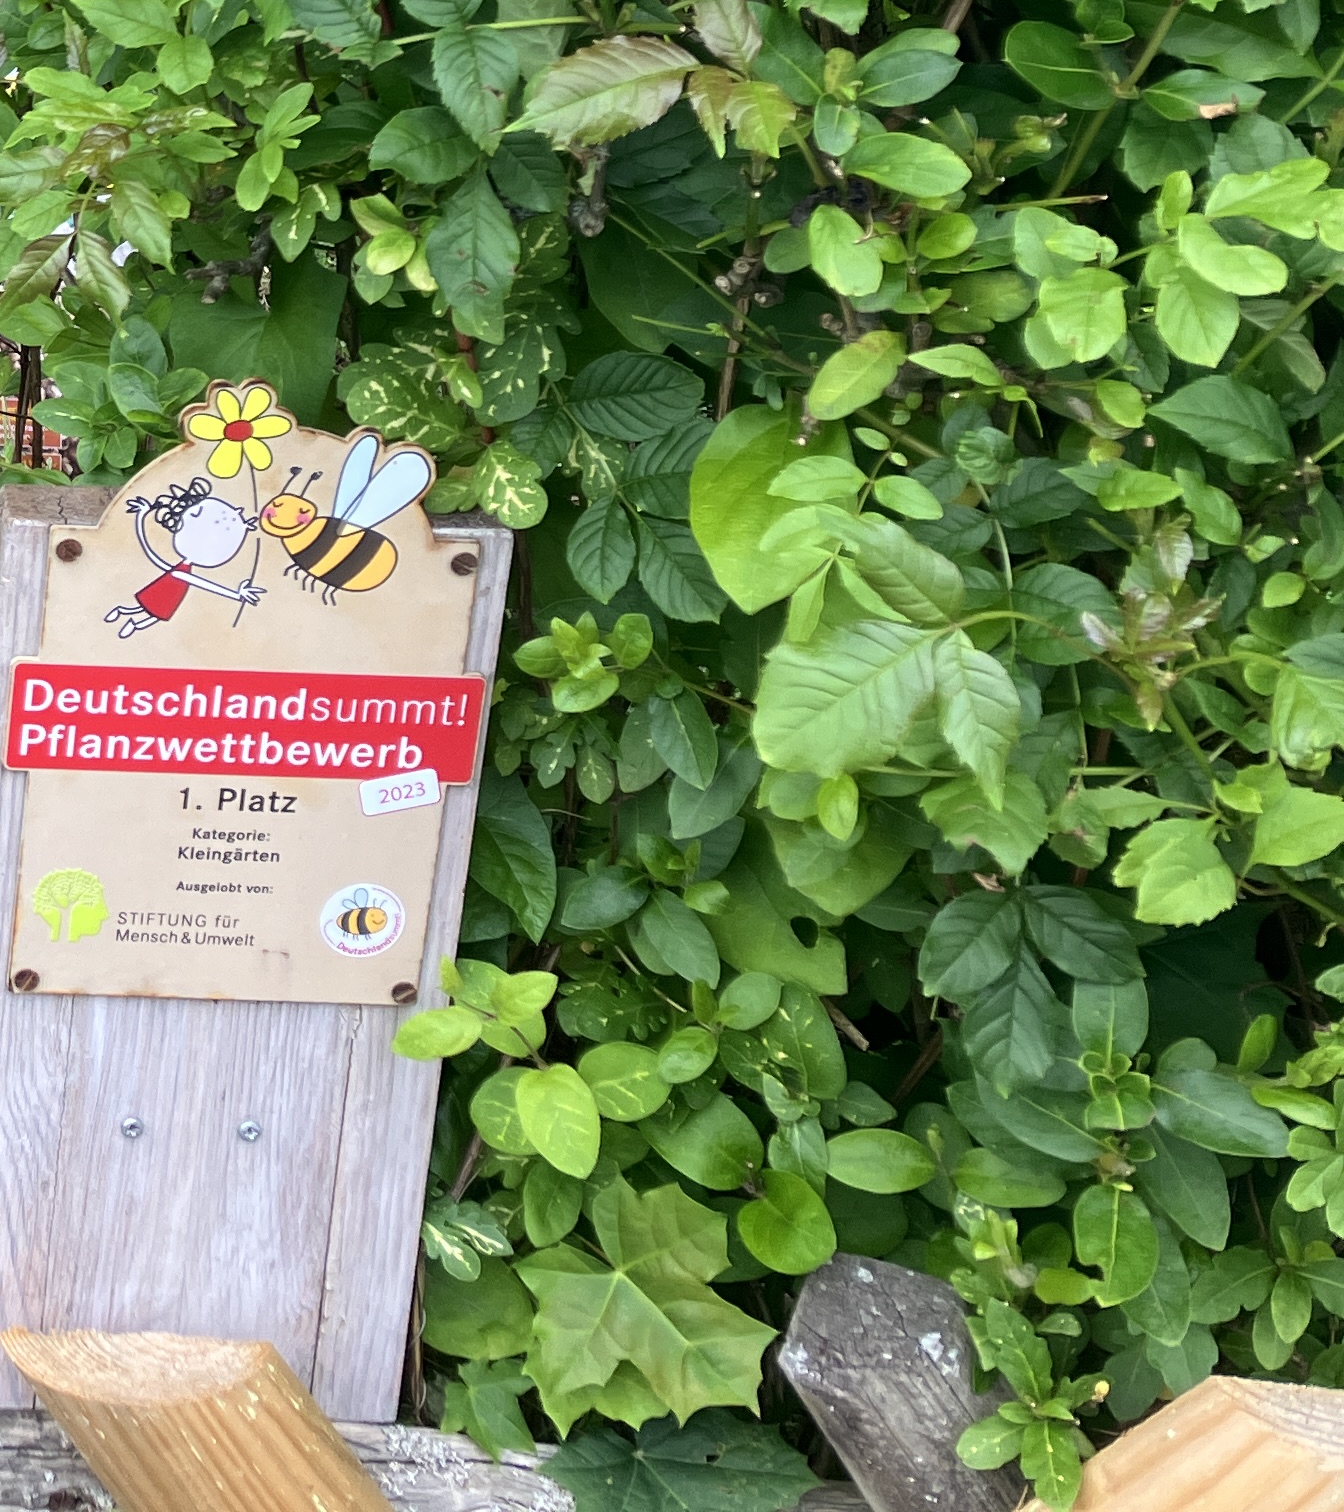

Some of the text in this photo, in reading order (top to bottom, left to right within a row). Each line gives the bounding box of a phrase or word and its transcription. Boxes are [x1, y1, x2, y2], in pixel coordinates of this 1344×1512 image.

[22, 678, 469, 727] Deutschlandsummt!
[18, 723, 423, 770] Pflanzwettbewerb
[179, 787, 298, 814] 1. Platz
[378, 780, 427, 805] 2023
[192, 827, 271, 844] Kategorie:
[177, 846, 281, 865] Kleingärten
[175, 880, 274, 895] Ausgelobt von:
[116, 911, 240, 929] STIFTUNG für
